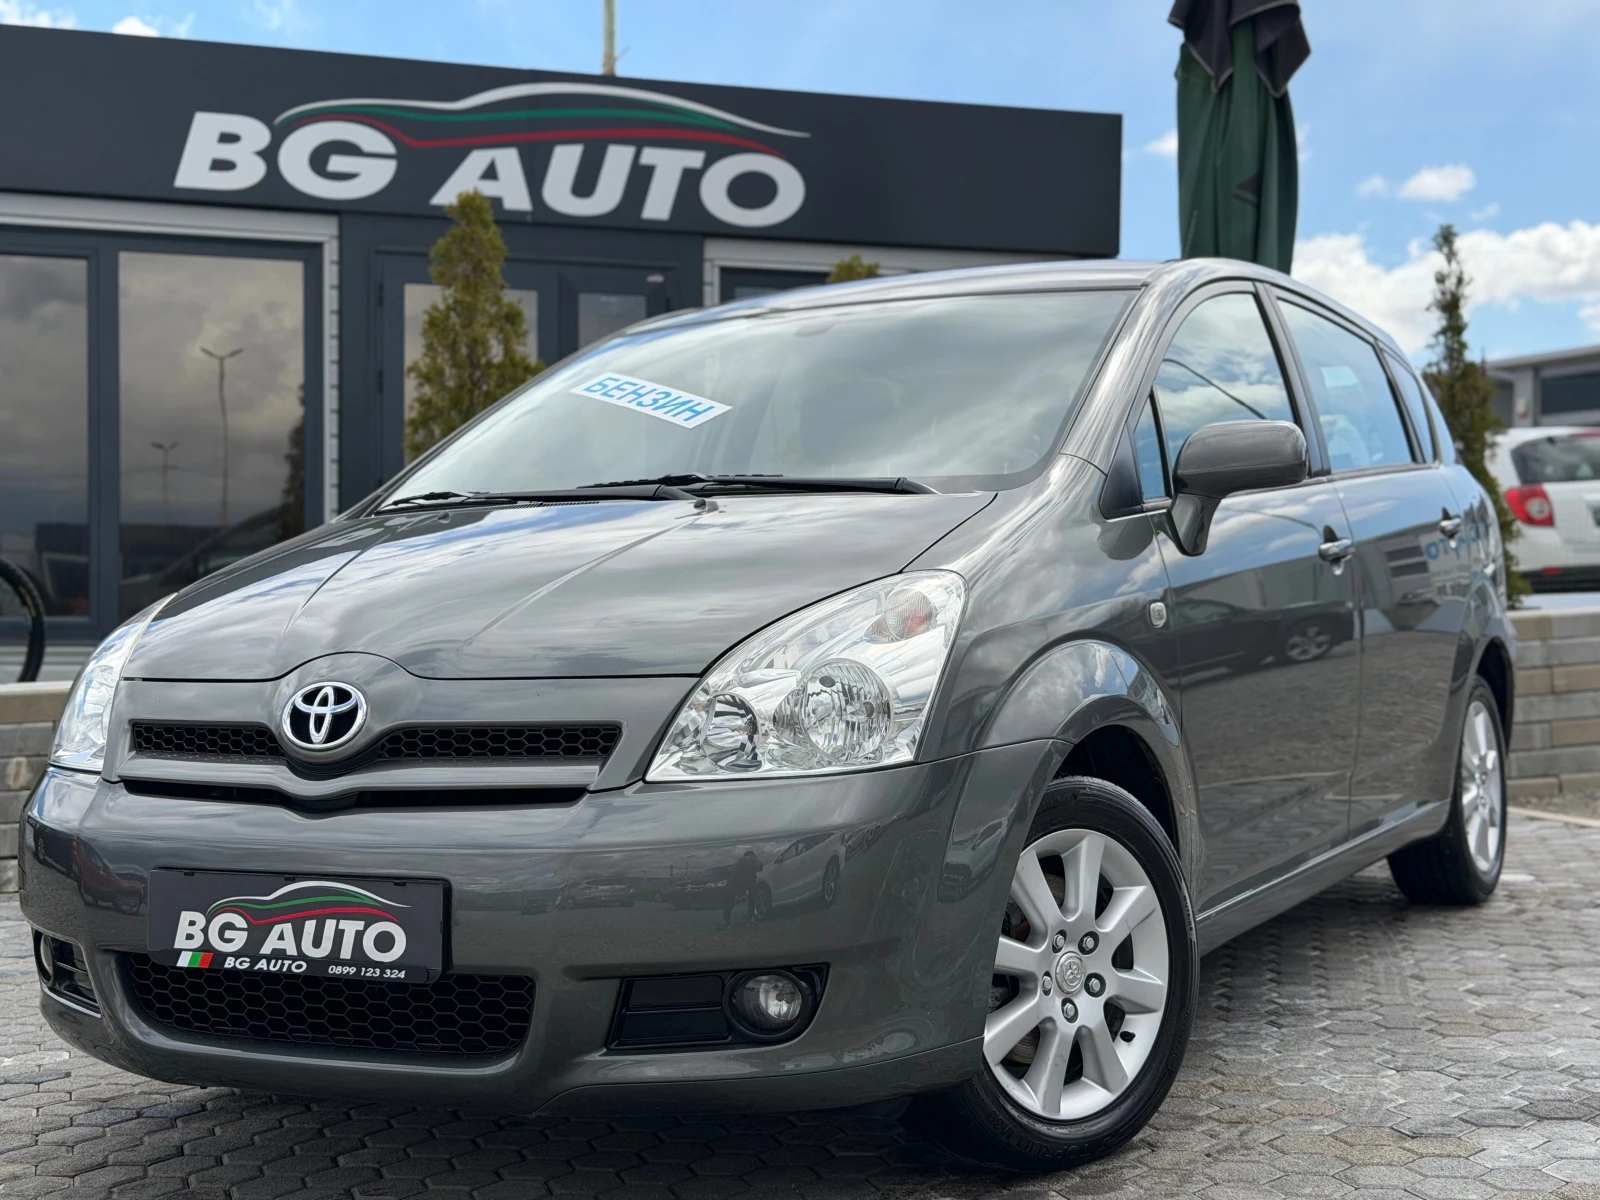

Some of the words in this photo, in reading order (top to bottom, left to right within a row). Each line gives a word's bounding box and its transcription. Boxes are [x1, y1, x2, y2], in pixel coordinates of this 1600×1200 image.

[173, 111, 397, 200] BG
[430, 144, 805, 228] AUTO
[583, 376, 716, 422] БЕНЗИН
[174, 910, 248, 953] BG
[258, 918, 407, 963] AUTO
[223, 956, 251, 970] BG
[254, 958, 307, 974] AUTO
[327, 965, 357, 977] 0899
[360, 967, 381, 977] 123
[383, 968, 406, 979] 324
